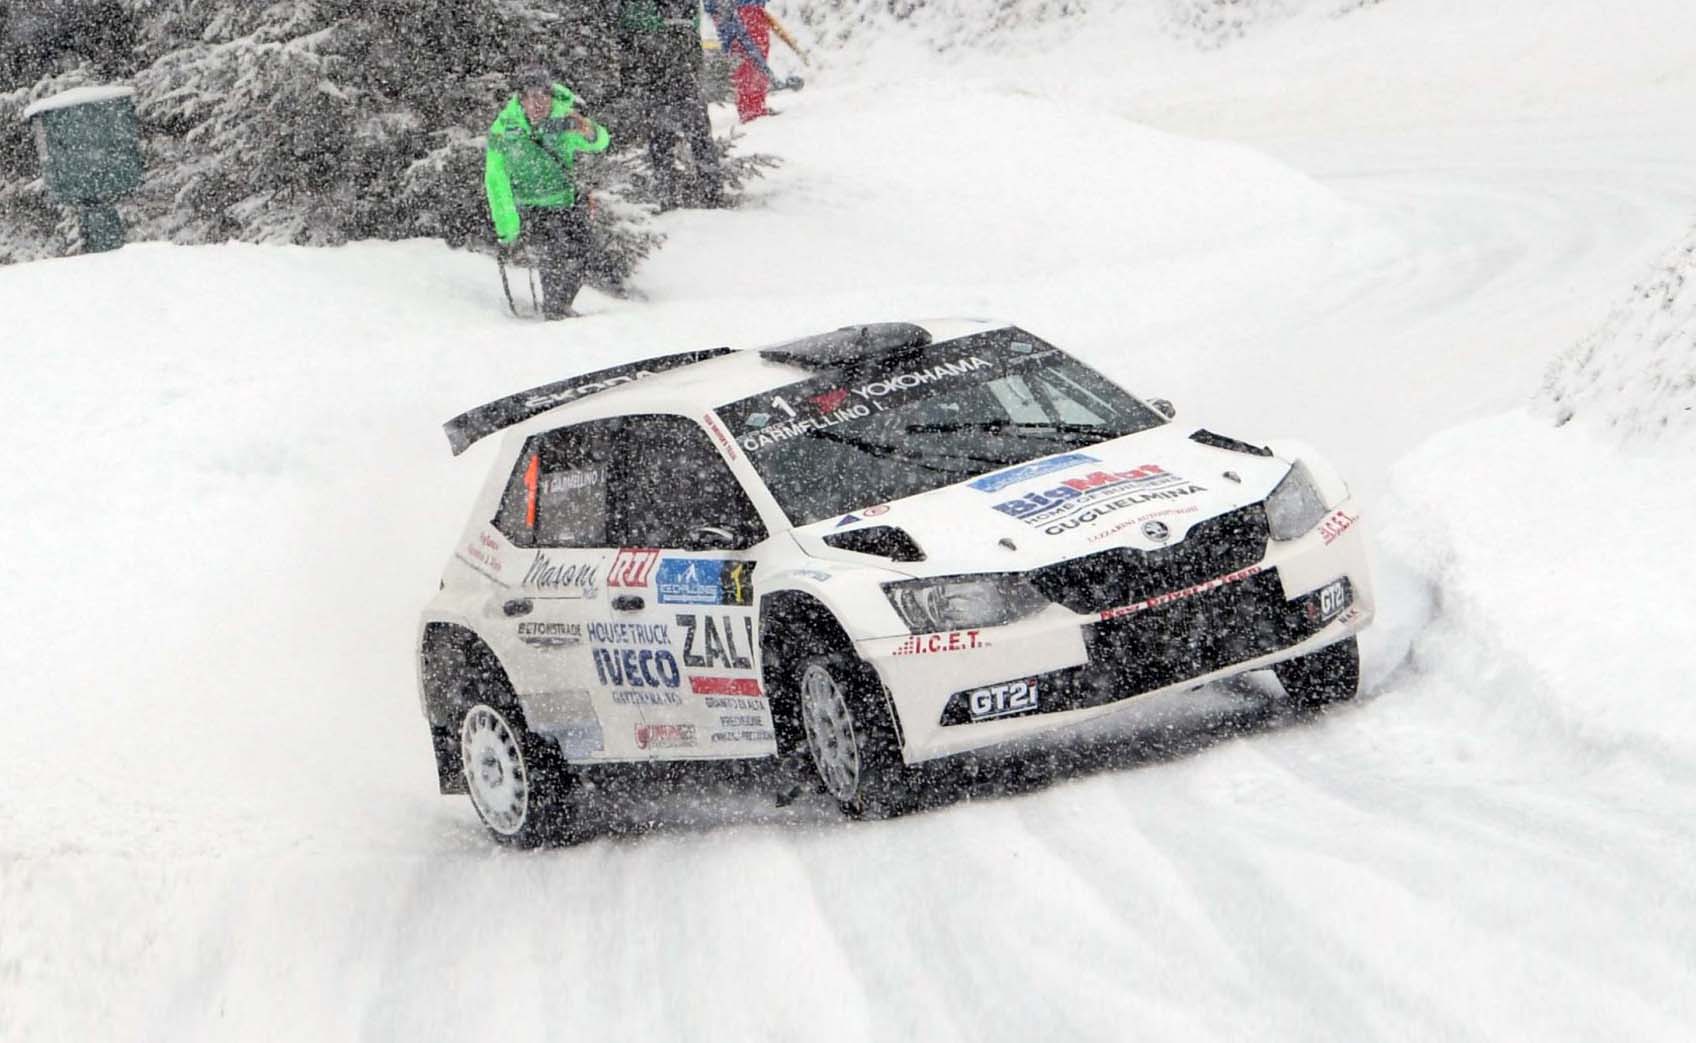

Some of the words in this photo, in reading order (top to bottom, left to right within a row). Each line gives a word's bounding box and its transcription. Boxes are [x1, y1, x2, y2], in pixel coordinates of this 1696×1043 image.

[771, 395, 797, 418] 1
[851, 356, 993, 400] YOKOHAMA
[743, 404, 870, 451] CARMELLINO
[523, 453, 539, 528] 1
[992, 464, 1165, 518] BigMat
[1025, 502, 1073, 525] HOME
[1077, 493, 1099, 505] OF
[1045, 484, 1208, 536] GUGLIELMINA
[521, 549, 598, 591] Masoni
[731, 564, 745, 602] 1
[914, 630, 983, 655] I.C.E.T.
[592, 648, 682, 689] IVECO
[970, 678, 1038, 716] GT2i
